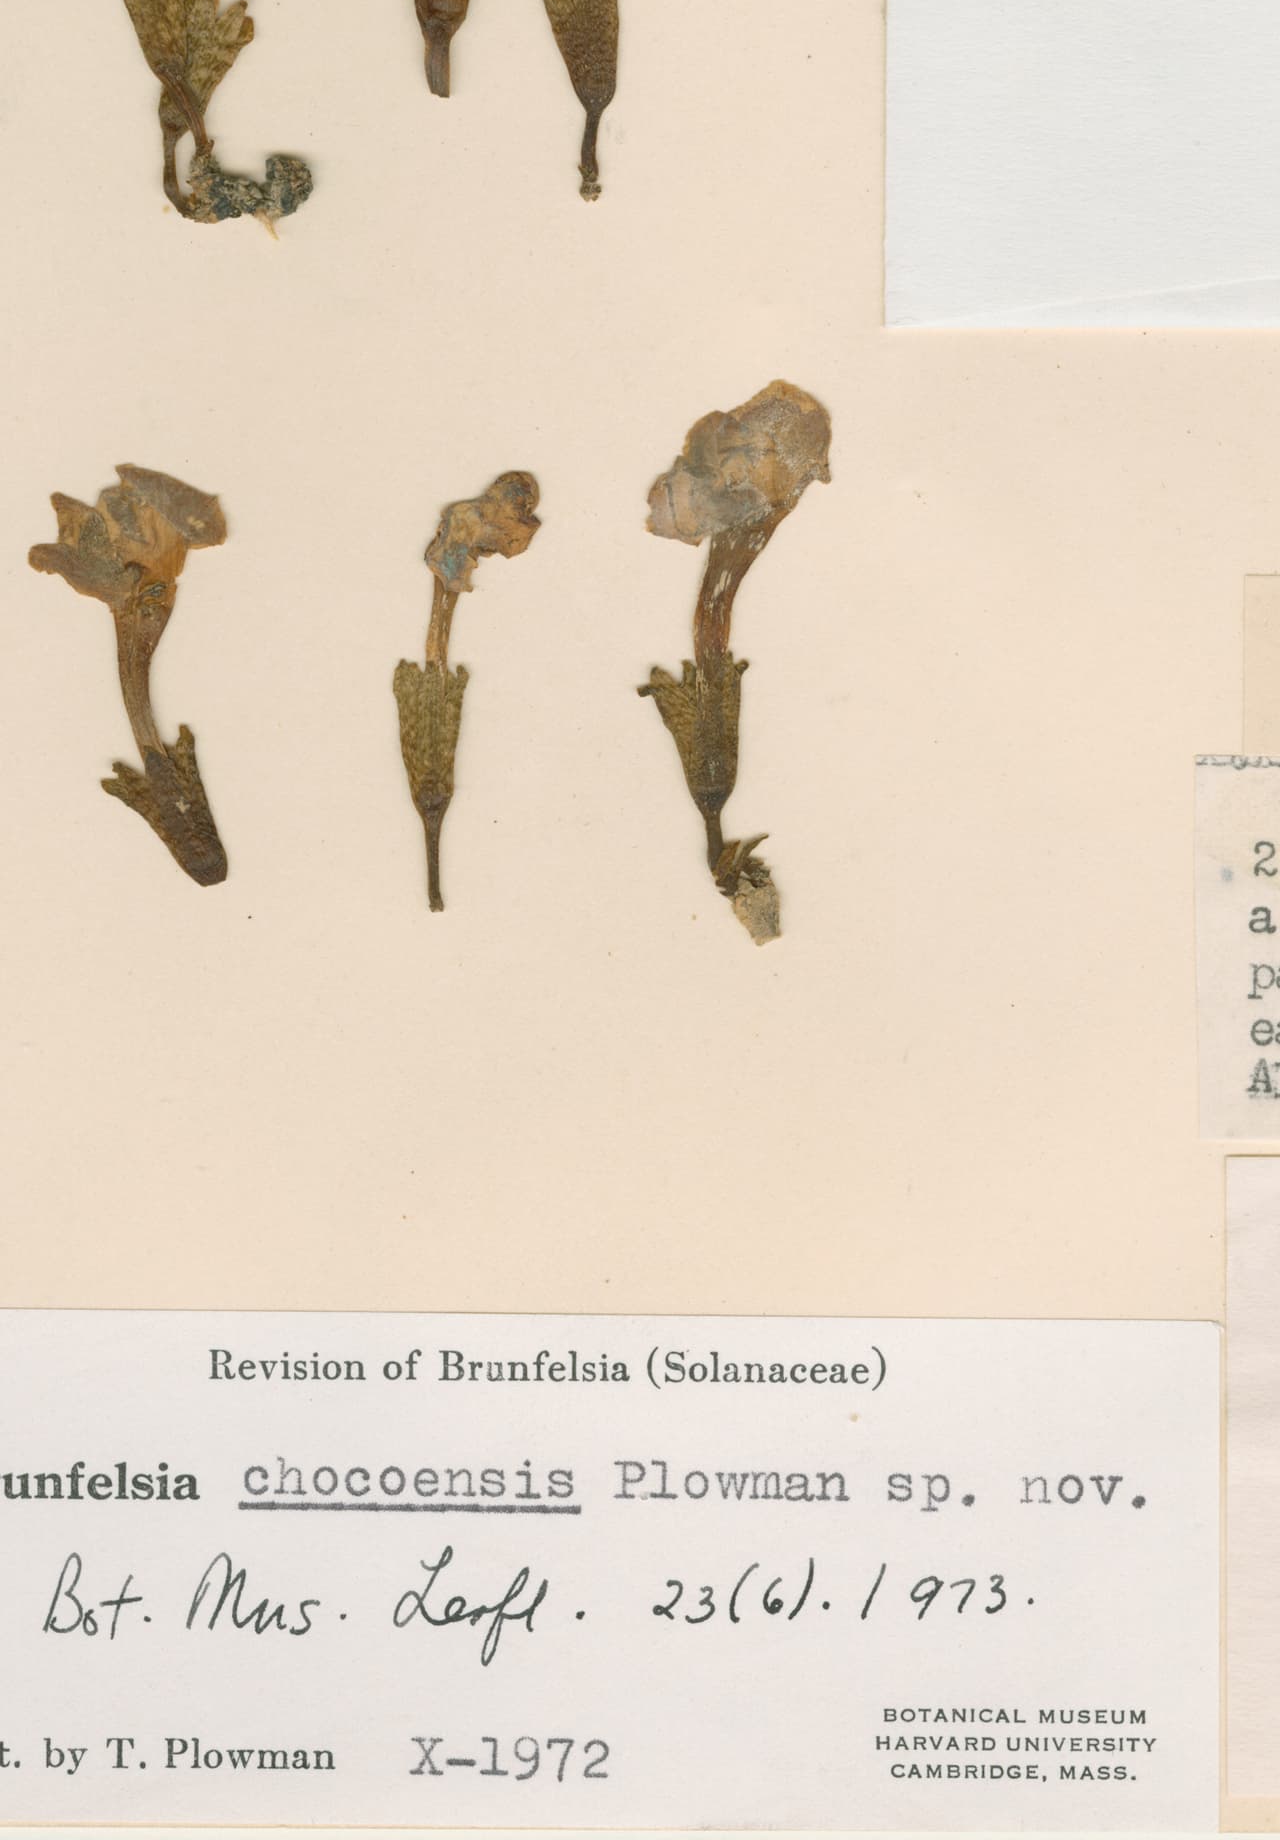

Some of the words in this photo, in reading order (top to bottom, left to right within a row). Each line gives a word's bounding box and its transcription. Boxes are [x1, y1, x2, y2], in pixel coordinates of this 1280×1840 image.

[1253, 840, 1279, 878] 2
[1248, 906, 1278, 935] a
[208, 1348, 367, 1381] Revision
[382, 1348, 423, 1381] of
[437, 1349, 631, 1383] Brunfelsia
[646, 1345, 887, 1392] (Solanaceae)
[238, 1456, 574, 1500] chocoensis
[613, 1459, 851, 1503] Plowman
[887, 1472, 976, 1513] sp.
[1019, 1473, 1147, 1510] nov.
[42, 1551, 152, 1641] Bot.
[883, 1707, 1027, 1724] BOTANICAL
[1038, 1709, 1147, 1725] MUSEUM
[43, 1737, 89, 1776] by
[105, 1737, 147, 1770] T.
[164, 1737, 337, 1771] Plowman
[408, 1736, 610, 1783] X-1972
[875, 1735, 997, 1752] HARVARD
[1006, 1736, 1157, 1753] UNIVERSITY
[890, 1763, 1048, 1783] CAMBRIDGE,
[1059, 1765, 1137, 1781] MASS.
